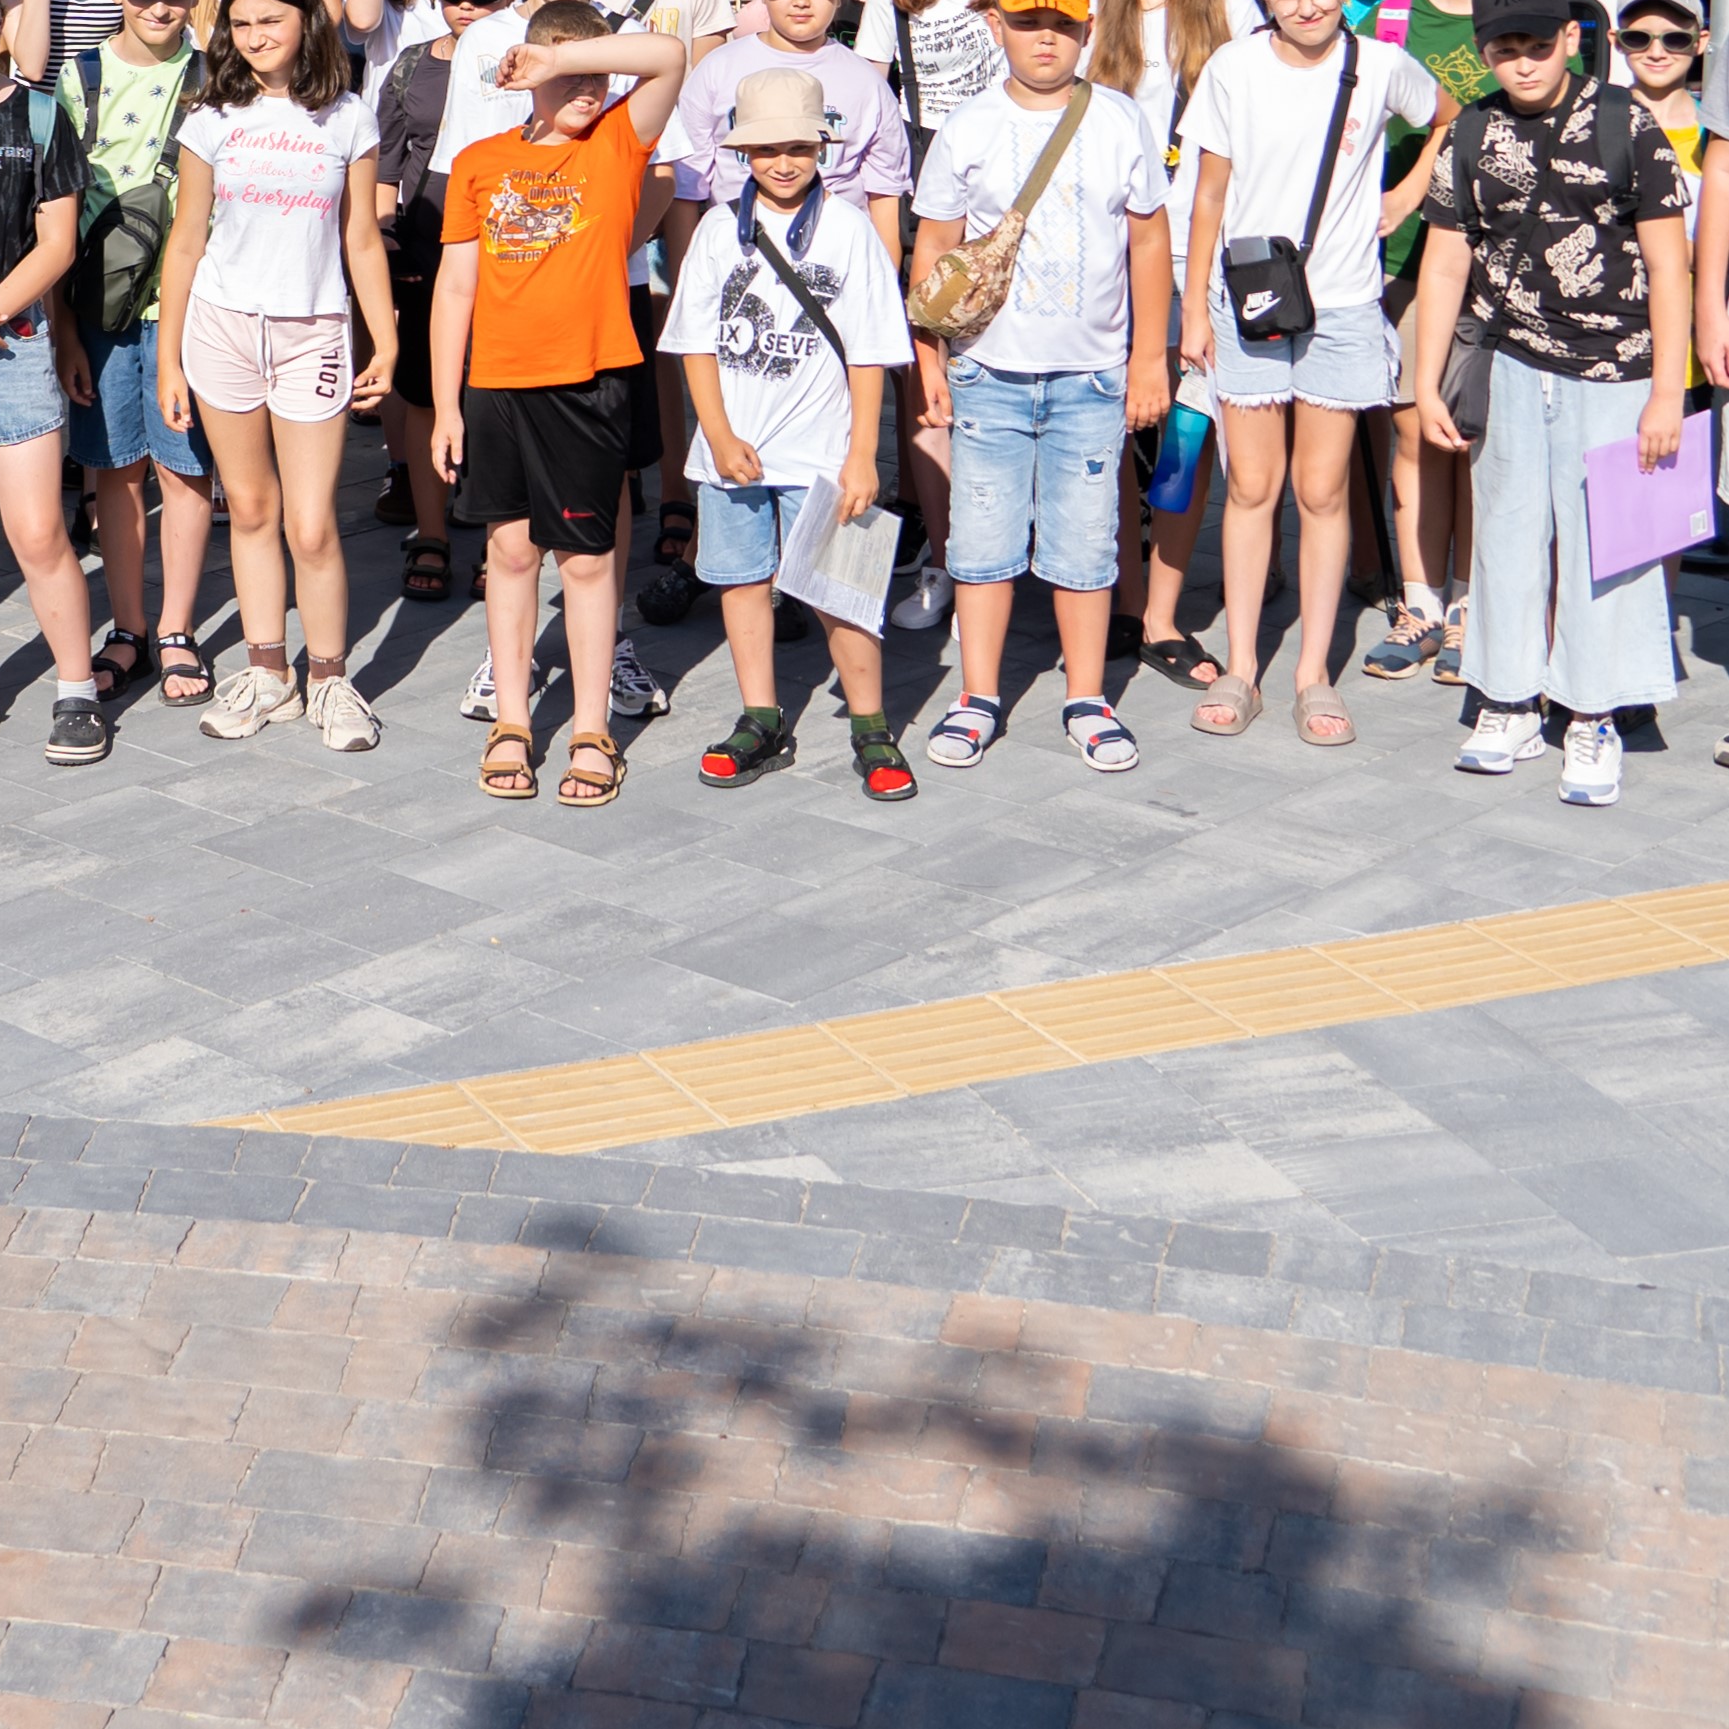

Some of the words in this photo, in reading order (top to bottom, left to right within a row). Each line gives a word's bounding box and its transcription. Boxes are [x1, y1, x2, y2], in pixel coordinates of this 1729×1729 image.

[1246, 290, 1273, 310] NIKE
[718, 323, 741, 345] IX
[763, 332, 821, 357] SEVE
